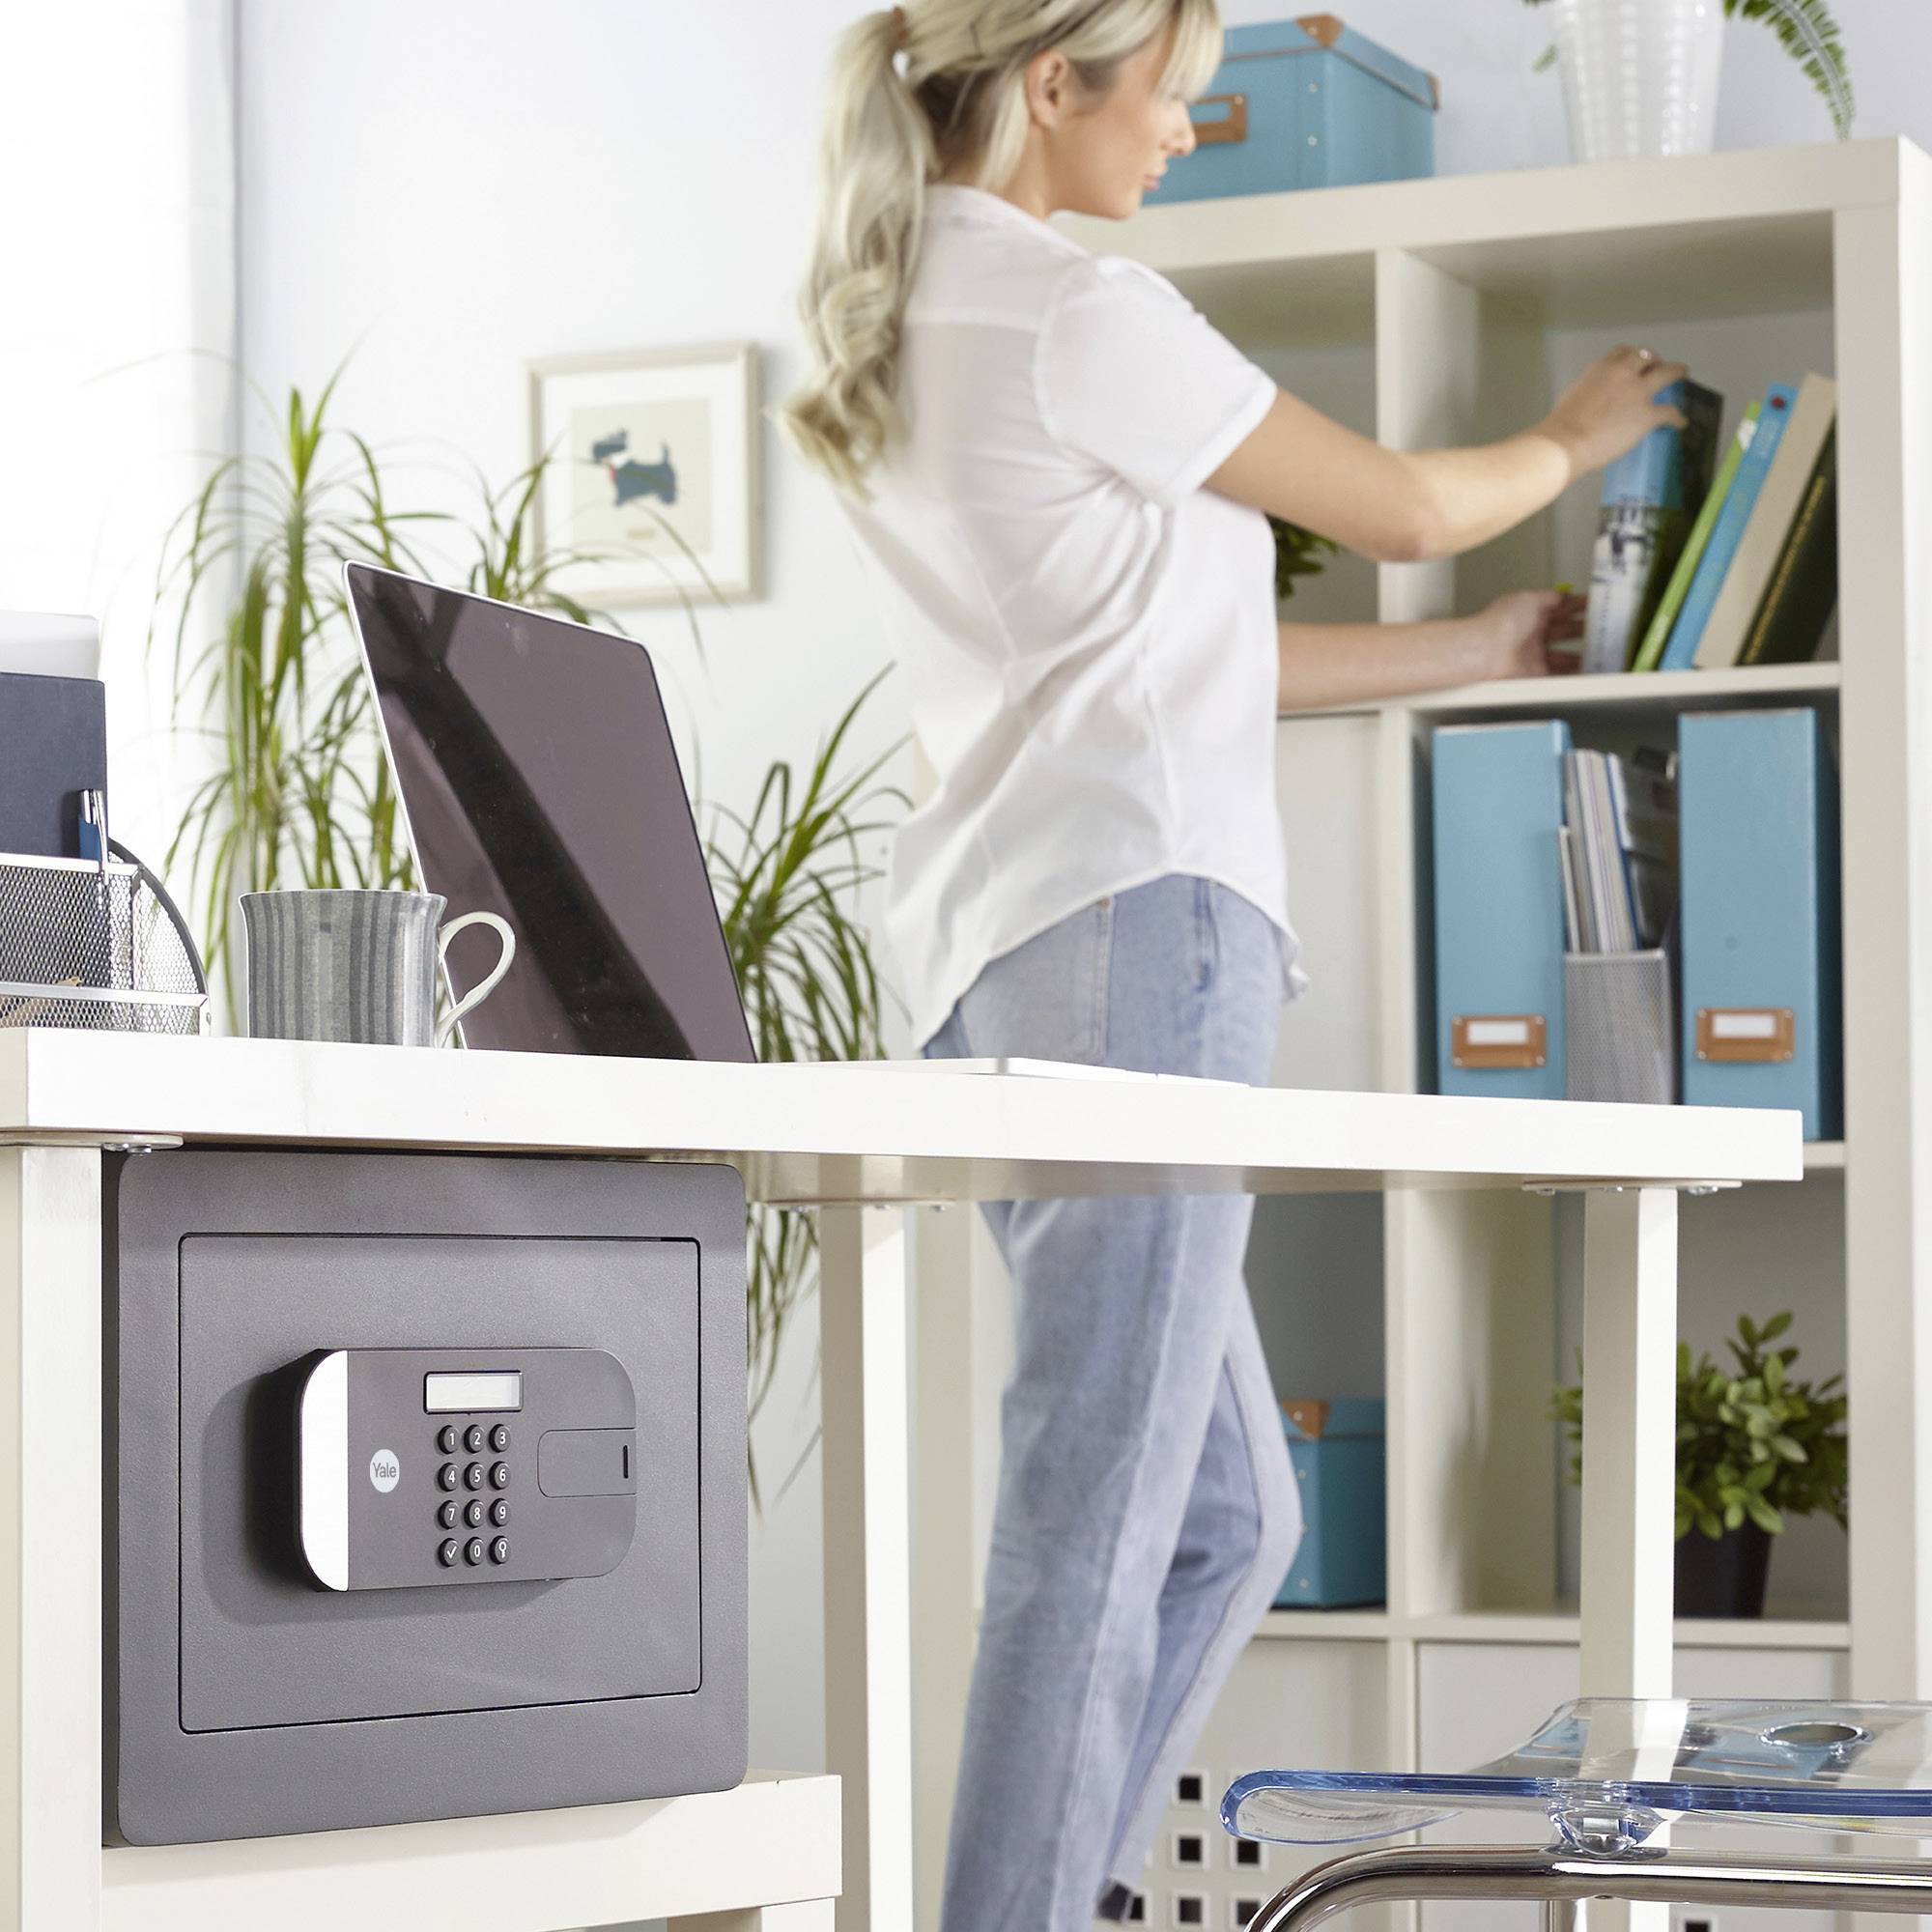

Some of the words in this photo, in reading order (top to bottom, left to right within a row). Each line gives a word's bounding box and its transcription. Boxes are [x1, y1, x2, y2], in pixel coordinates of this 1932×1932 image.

[449, 1433, 455, 1446] 1
[473, 1432, 481, 1445] 2
[498, 1432, 506, 1445] 3
[373, 1462, 397, 1478] Yale
[448, 1470, 456, 1484] 4
[473, 1469, 481, 1483] 5
[498, 1468, 506, 1482] 6
[448, 1508, 456, 1521] 7
[473, 1507, 481, 1520] 8
[498, 1506, 506, 1520] 9
[473, 1545, 481, 1558] 0
